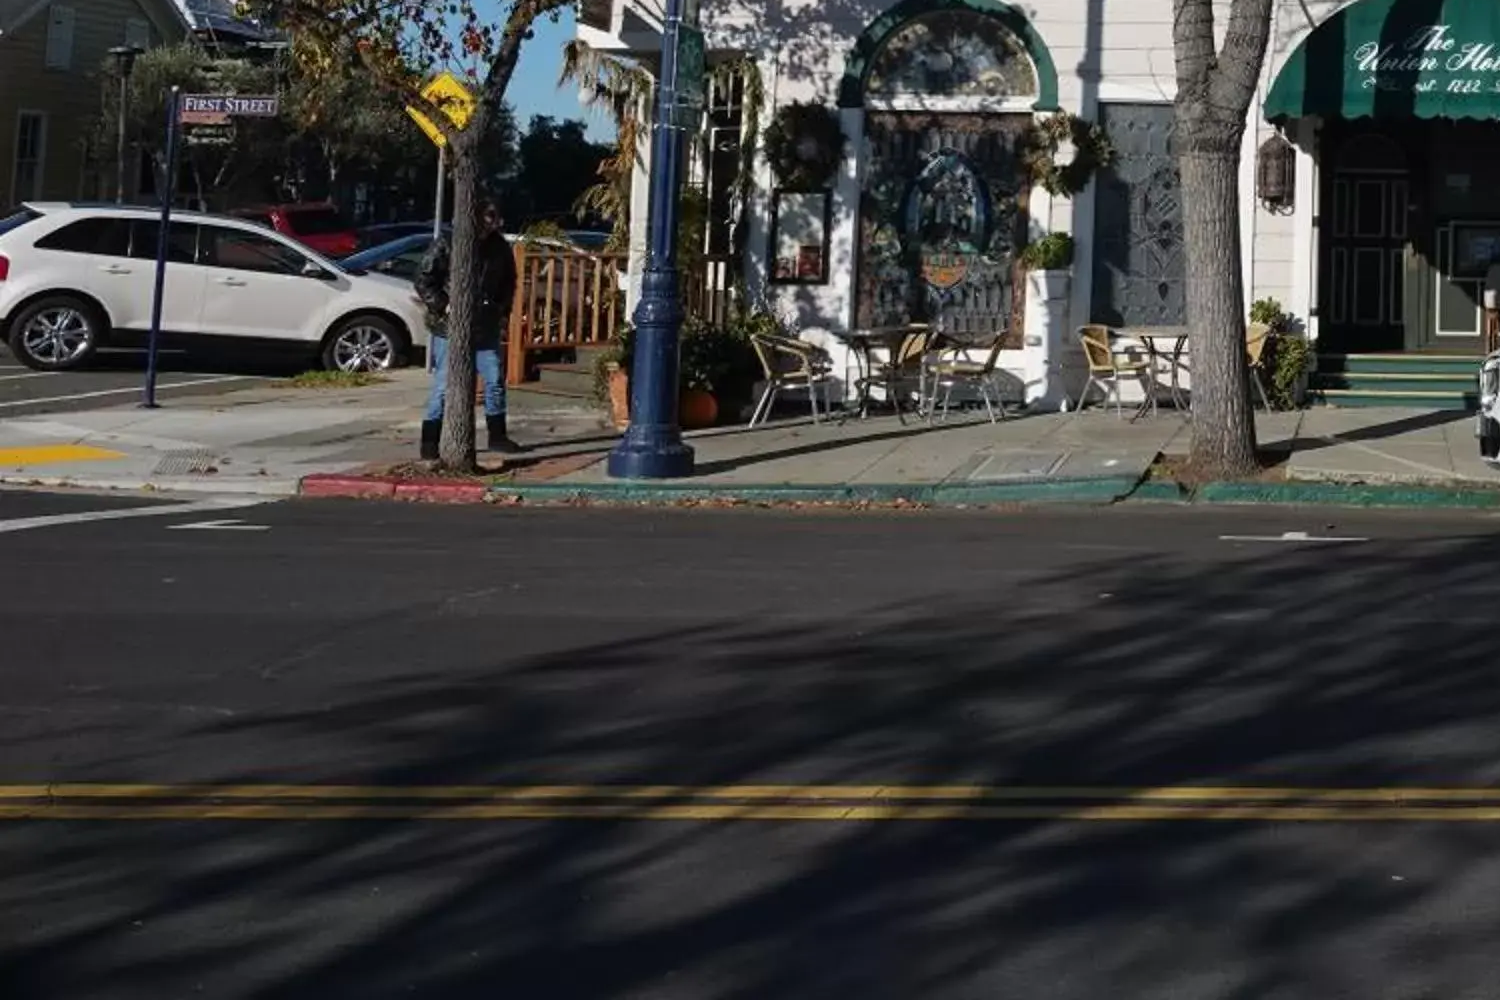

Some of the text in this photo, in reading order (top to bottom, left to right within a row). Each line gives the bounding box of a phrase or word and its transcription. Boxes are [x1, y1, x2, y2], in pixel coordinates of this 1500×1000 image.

[1404, 25, 1455, 51] The
[1354, 41, 1439, 71] Union
[185, 97, 274, 113] FIRST STREET
